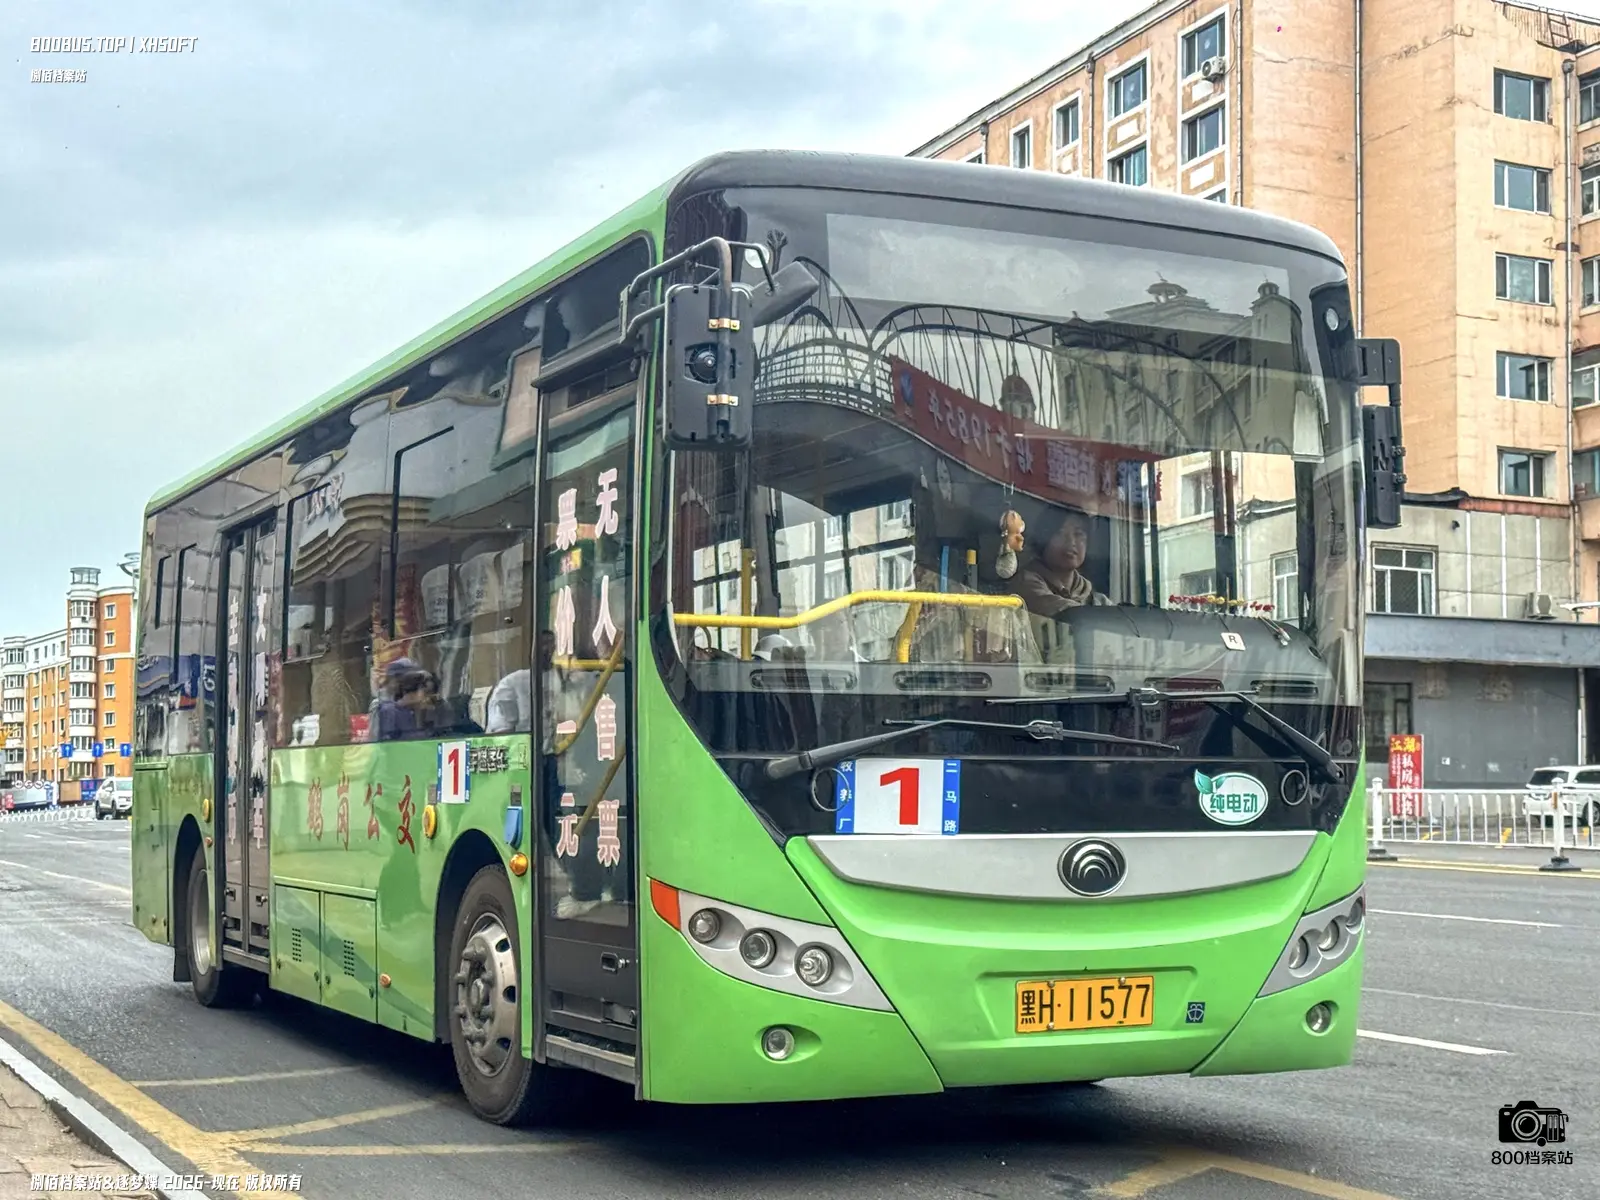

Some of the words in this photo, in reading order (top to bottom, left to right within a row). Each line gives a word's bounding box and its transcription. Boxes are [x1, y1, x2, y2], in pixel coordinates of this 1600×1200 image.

[592, 467, 621, 868] 无人售票
[1228, 635, 1238, 644] R
[555, 487, 579, 859] 票价一元
[447, 748, 460, 796] 1
[879, 767, 920, 826] 1
[943, 762, 958, 832] 二马路
[1209, 793, 1258, 814] 纯电动
